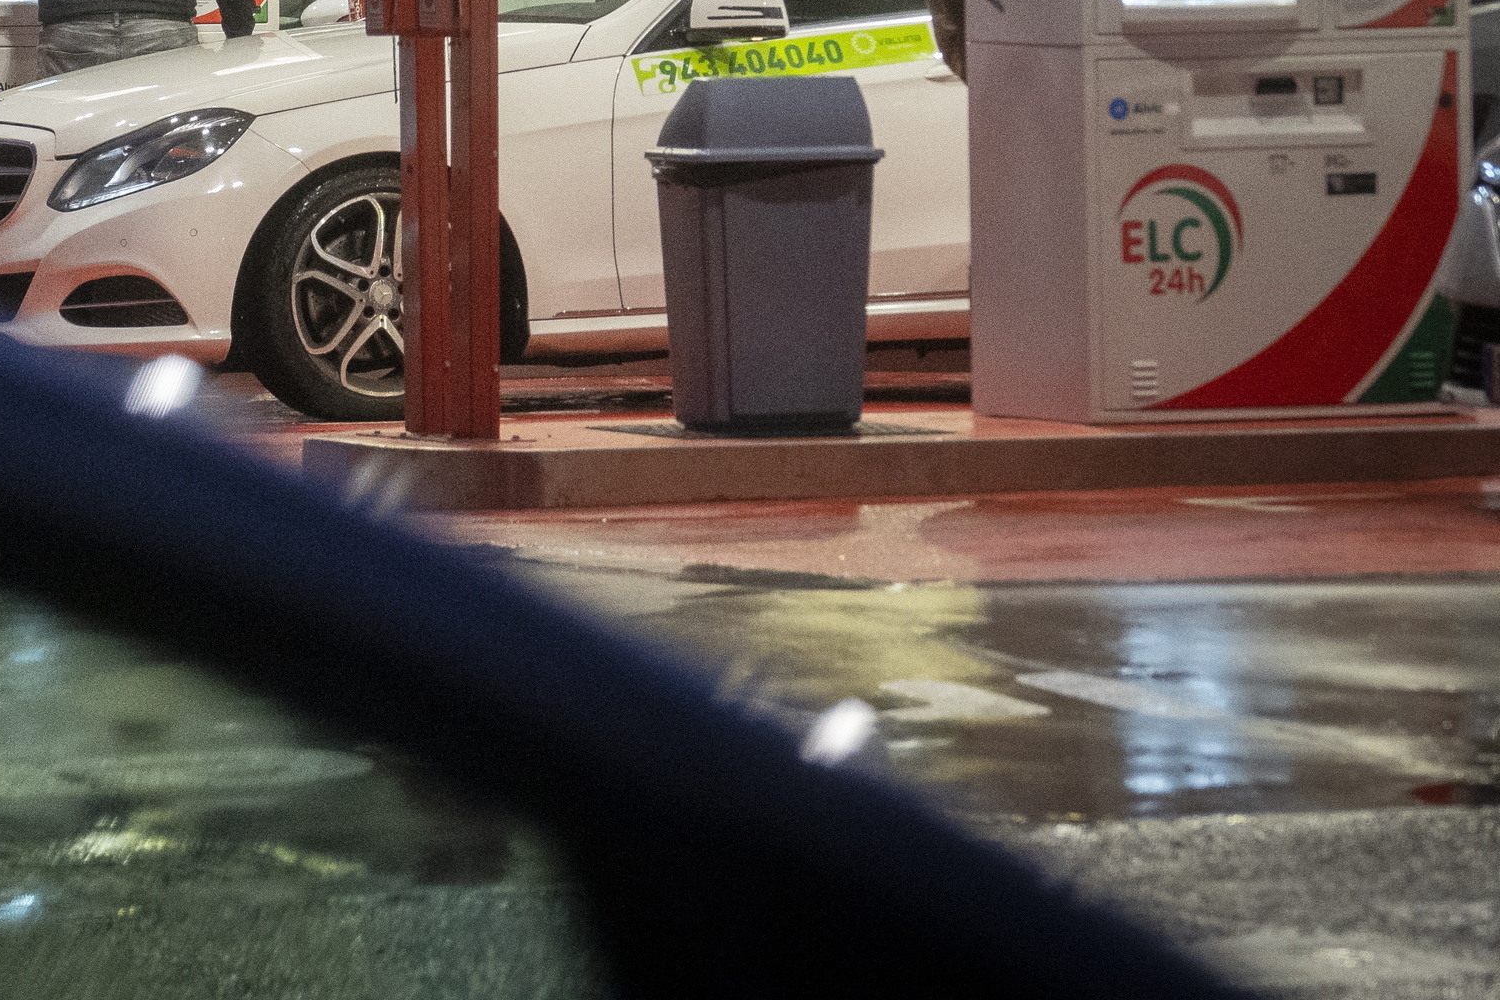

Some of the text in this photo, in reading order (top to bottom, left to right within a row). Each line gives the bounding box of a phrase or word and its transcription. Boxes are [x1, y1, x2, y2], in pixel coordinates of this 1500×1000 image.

[658, 39, 845, 86] 943 404040
[1121, 217, 1204, 264] ELC
[1150, 266, 1205, 296] 24h
